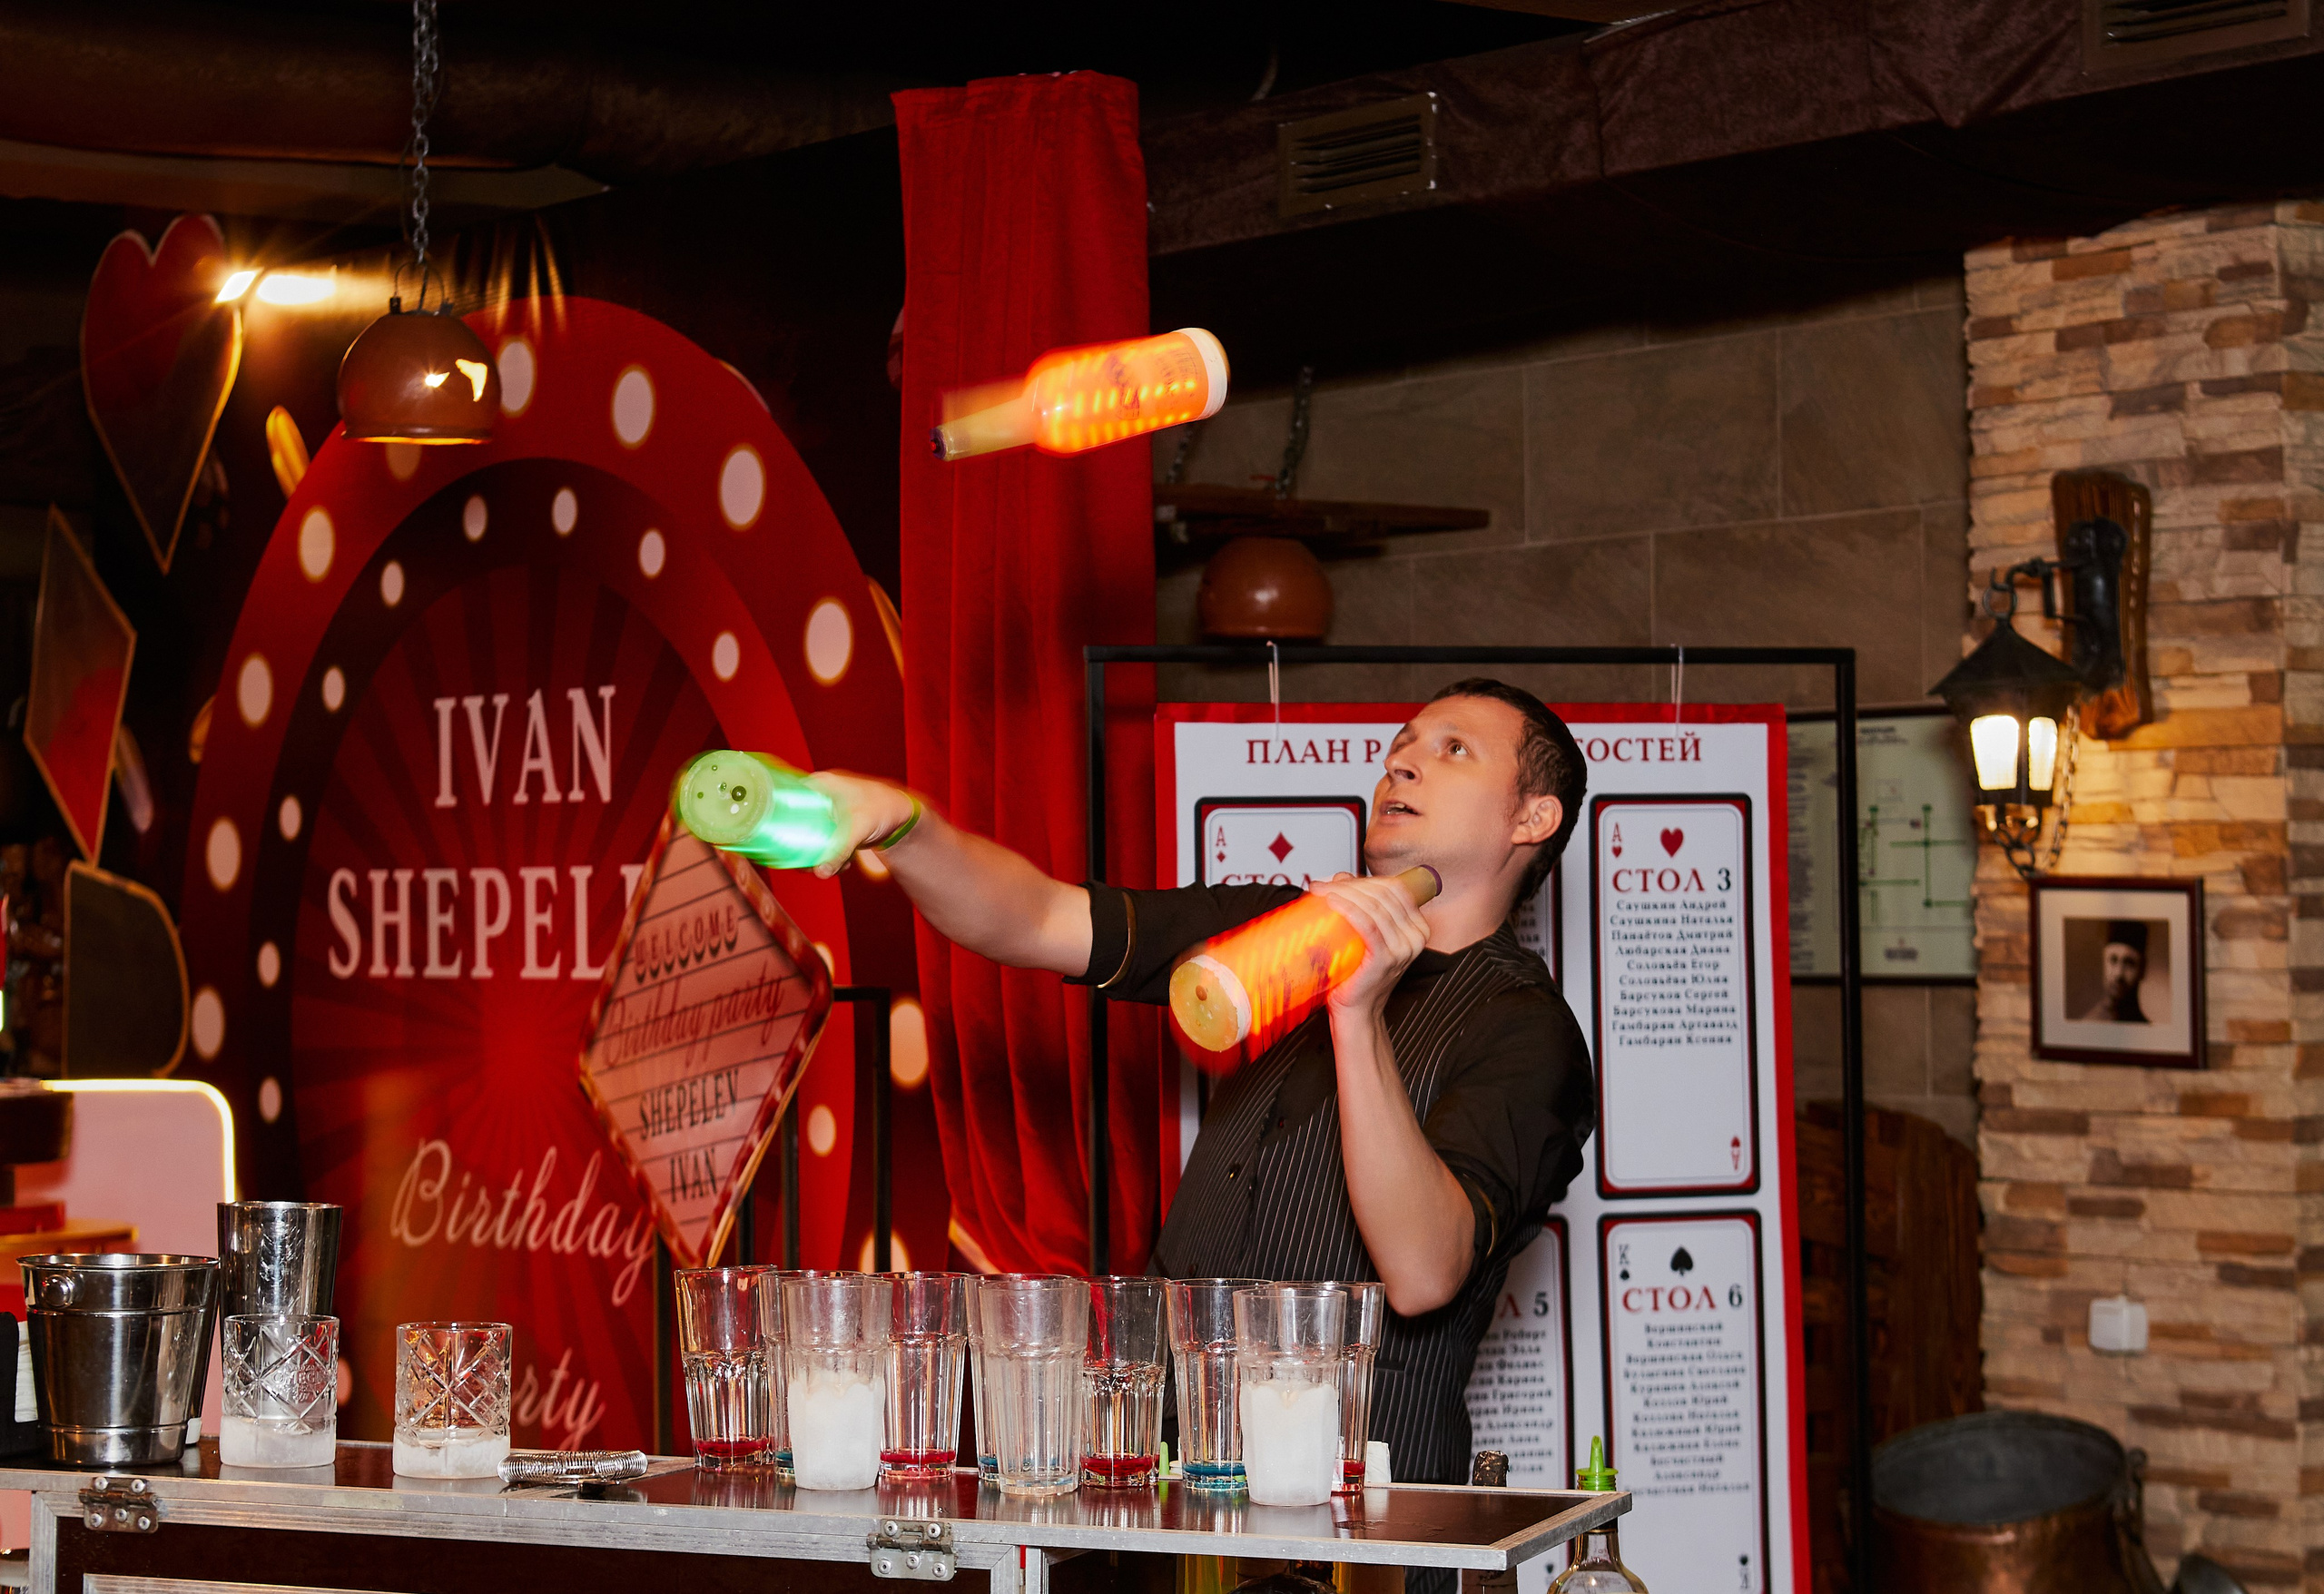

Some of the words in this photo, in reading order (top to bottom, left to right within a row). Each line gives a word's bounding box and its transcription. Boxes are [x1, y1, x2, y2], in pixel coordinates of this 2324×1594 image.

[434, 684, 616, 808] IVAN
[1246, 739, 1350, 763] ПЛАН
[1612, 868, 1706, 892] СТОЛ
[1718, 868, 1731, 891] 3
[639, 1068, 740, 1140] SHEPELEV
[669, 1147, 718, 1204] IVAN
[390, 1138, 657, 1307] Birthday
[1533, 1291, 1549, 1317] 5
[1622, 1285, 1717, 1313] СТОЛ
[1728, 1284, 1742, 1308] 6
[515, 1348, 606, 1451] rty
